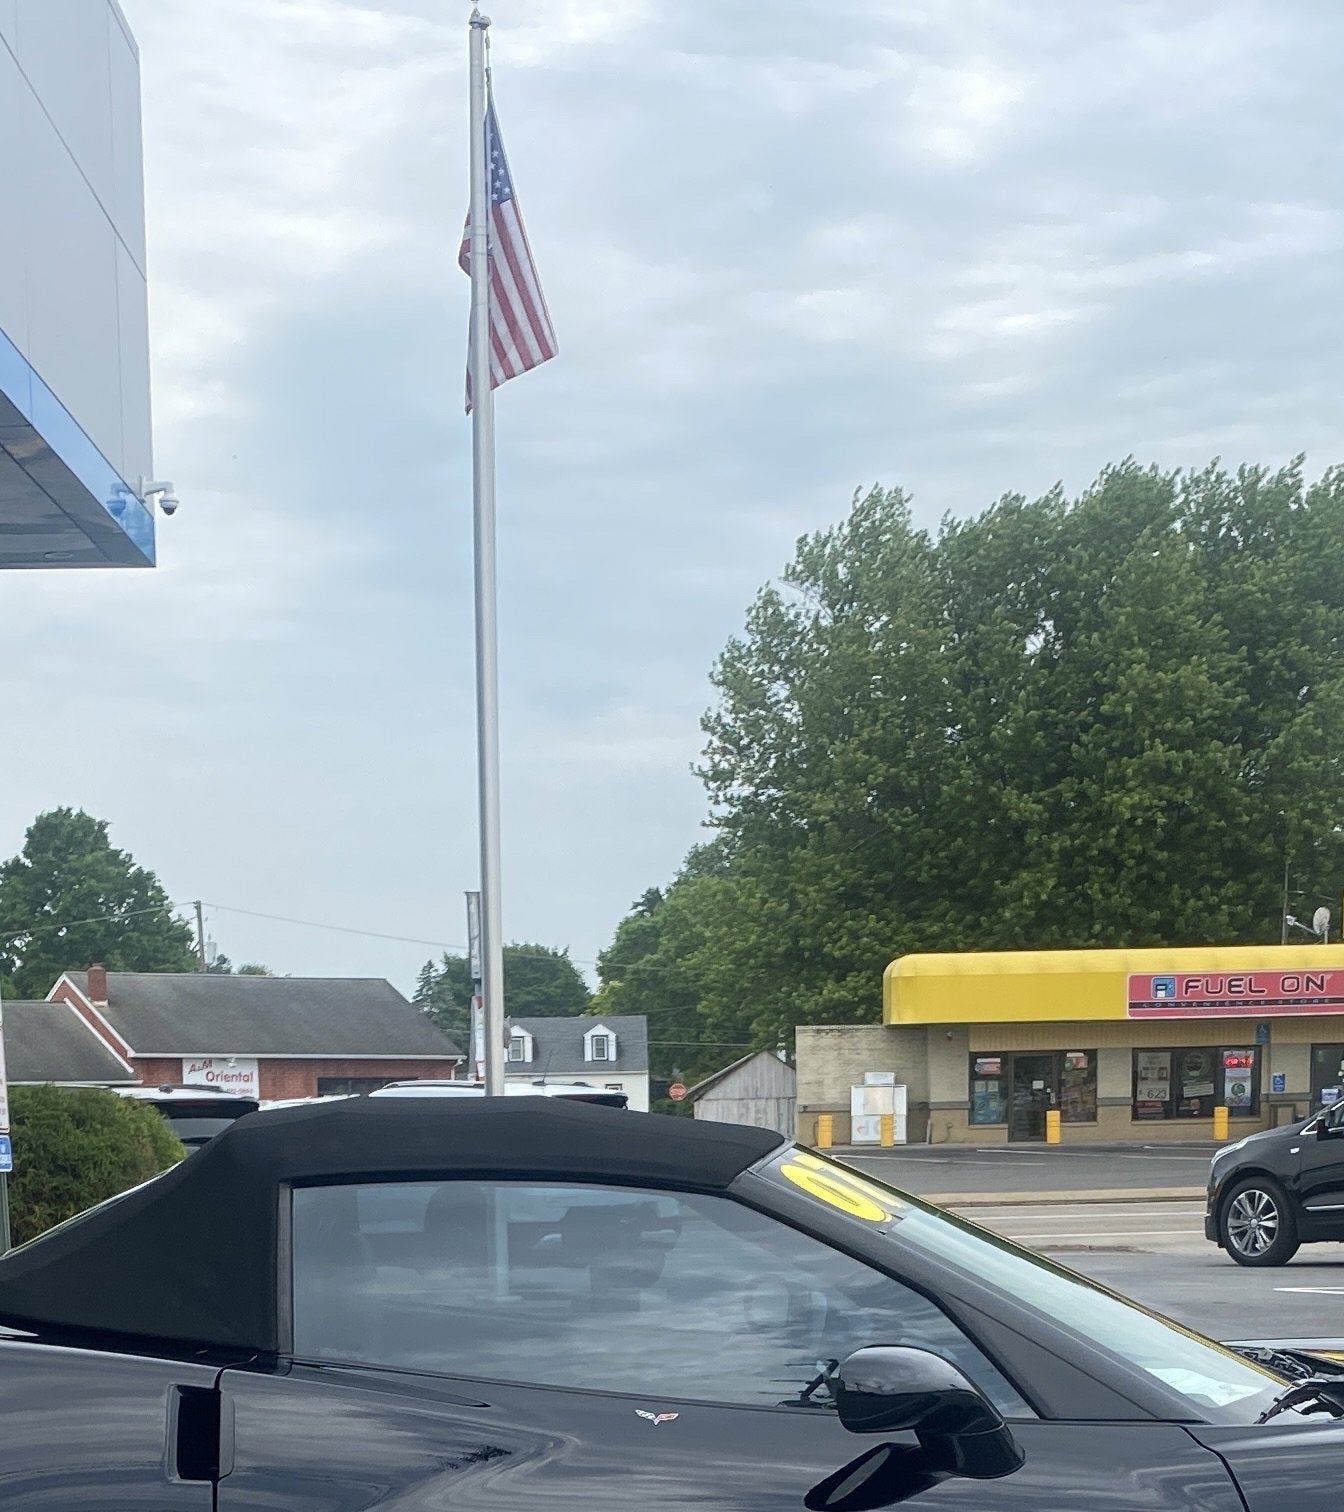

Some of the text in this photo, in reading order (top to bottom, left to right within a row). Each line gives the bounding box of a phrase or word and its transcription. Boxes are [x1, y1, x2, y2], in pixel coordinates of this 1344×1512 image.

[1184, 974, 1325, 995] FUEL ON
[1142, 1000, 1266, 1008] CONVENIENCE
[206, 1070, 254, 1083] Oriental
